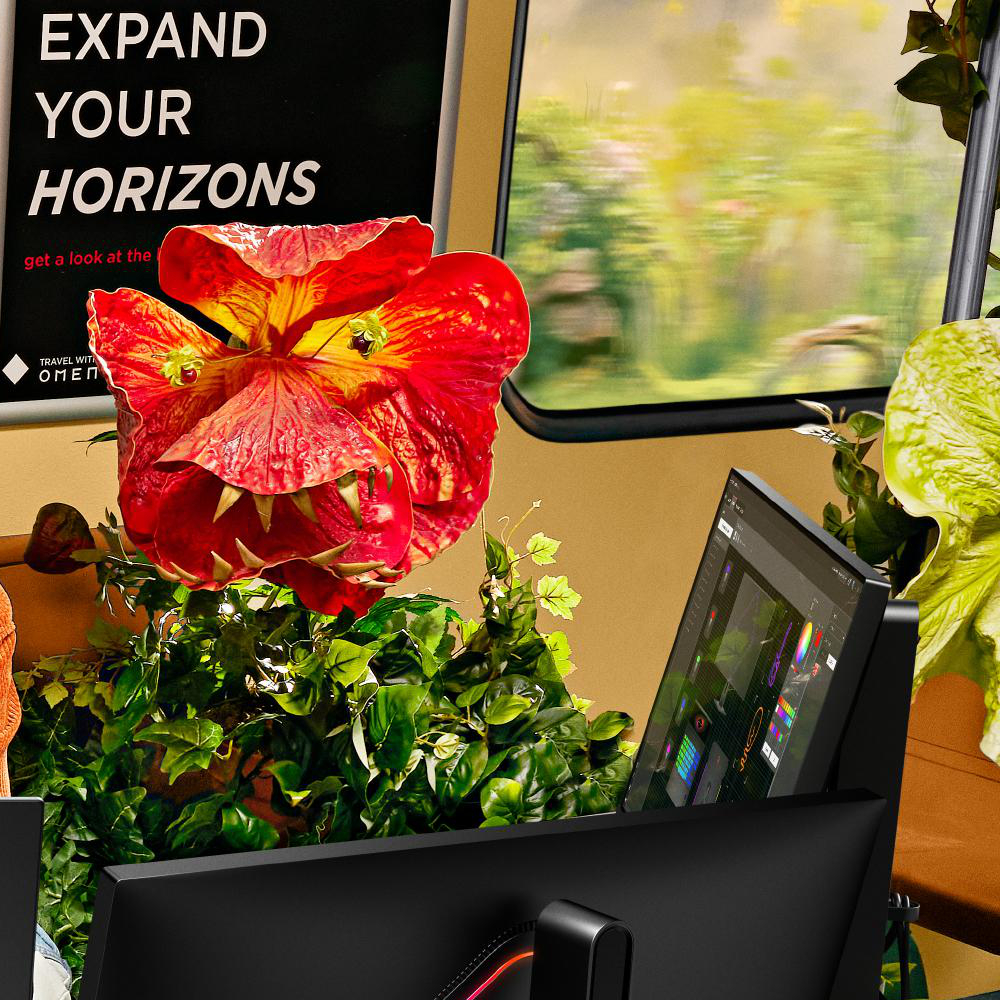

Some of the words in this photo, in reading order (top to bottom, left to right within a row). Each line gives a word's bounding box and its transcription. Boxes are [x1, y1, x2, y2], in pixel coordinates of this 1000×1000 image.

[40, 11, 267, 61] EXPAND
[35, 89, 192, 139] YOUR
[27, 160, 321, 216] HORIZONS
[24, 253, 50, 271] get
[54, 255, 64, 265] a
[70, 250, 103, 265] look
[106, 249, 121, 264] at
[127, 248, 152, 263] the
[39, 367, 98, 382] OMEN
[40, 356, 73, 366] TRAVEL
